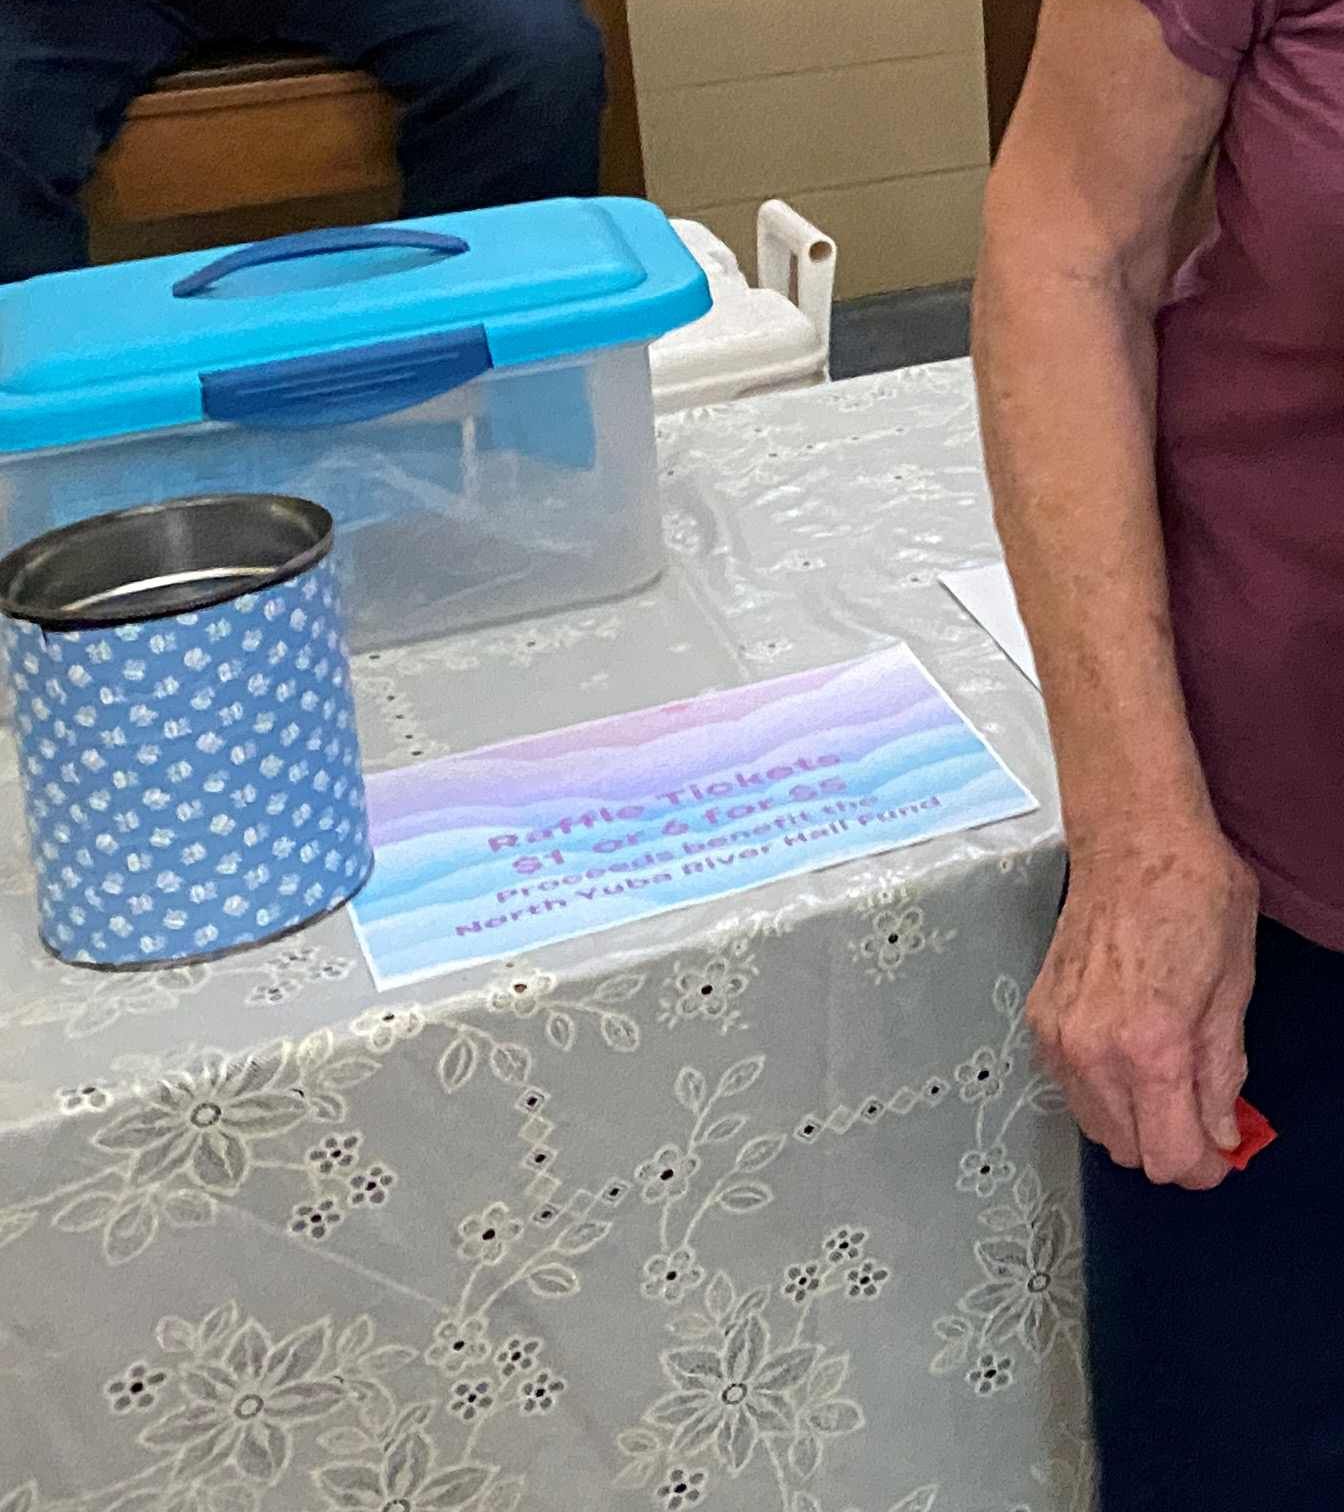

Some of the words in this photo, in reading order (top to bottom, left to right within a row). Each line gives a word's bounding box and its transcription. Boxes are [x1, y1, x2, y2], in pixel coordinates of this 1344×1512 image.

[488, 805, 645, 852] Raffle
[656, 754, 841, 805] Tickets
[496, 850, 675, 903] Proceeds
[682, 810, 810, 855] benefit
[821, 795, 879, 816] the
[513, 849, 564, 875] $1
[592, 830, 645, 854] or
[661, 818, 689, 836] 6
[704, 797, 774, 825] for
[788, 775, 847, 802] $5
[455, 898, 567, 936] North
[576, 872, 673, 900] Yuba
[682, 844, 771, 875] River
[784, 818, 849, 847] Hall
[857, 795, 941, 826] Fund
